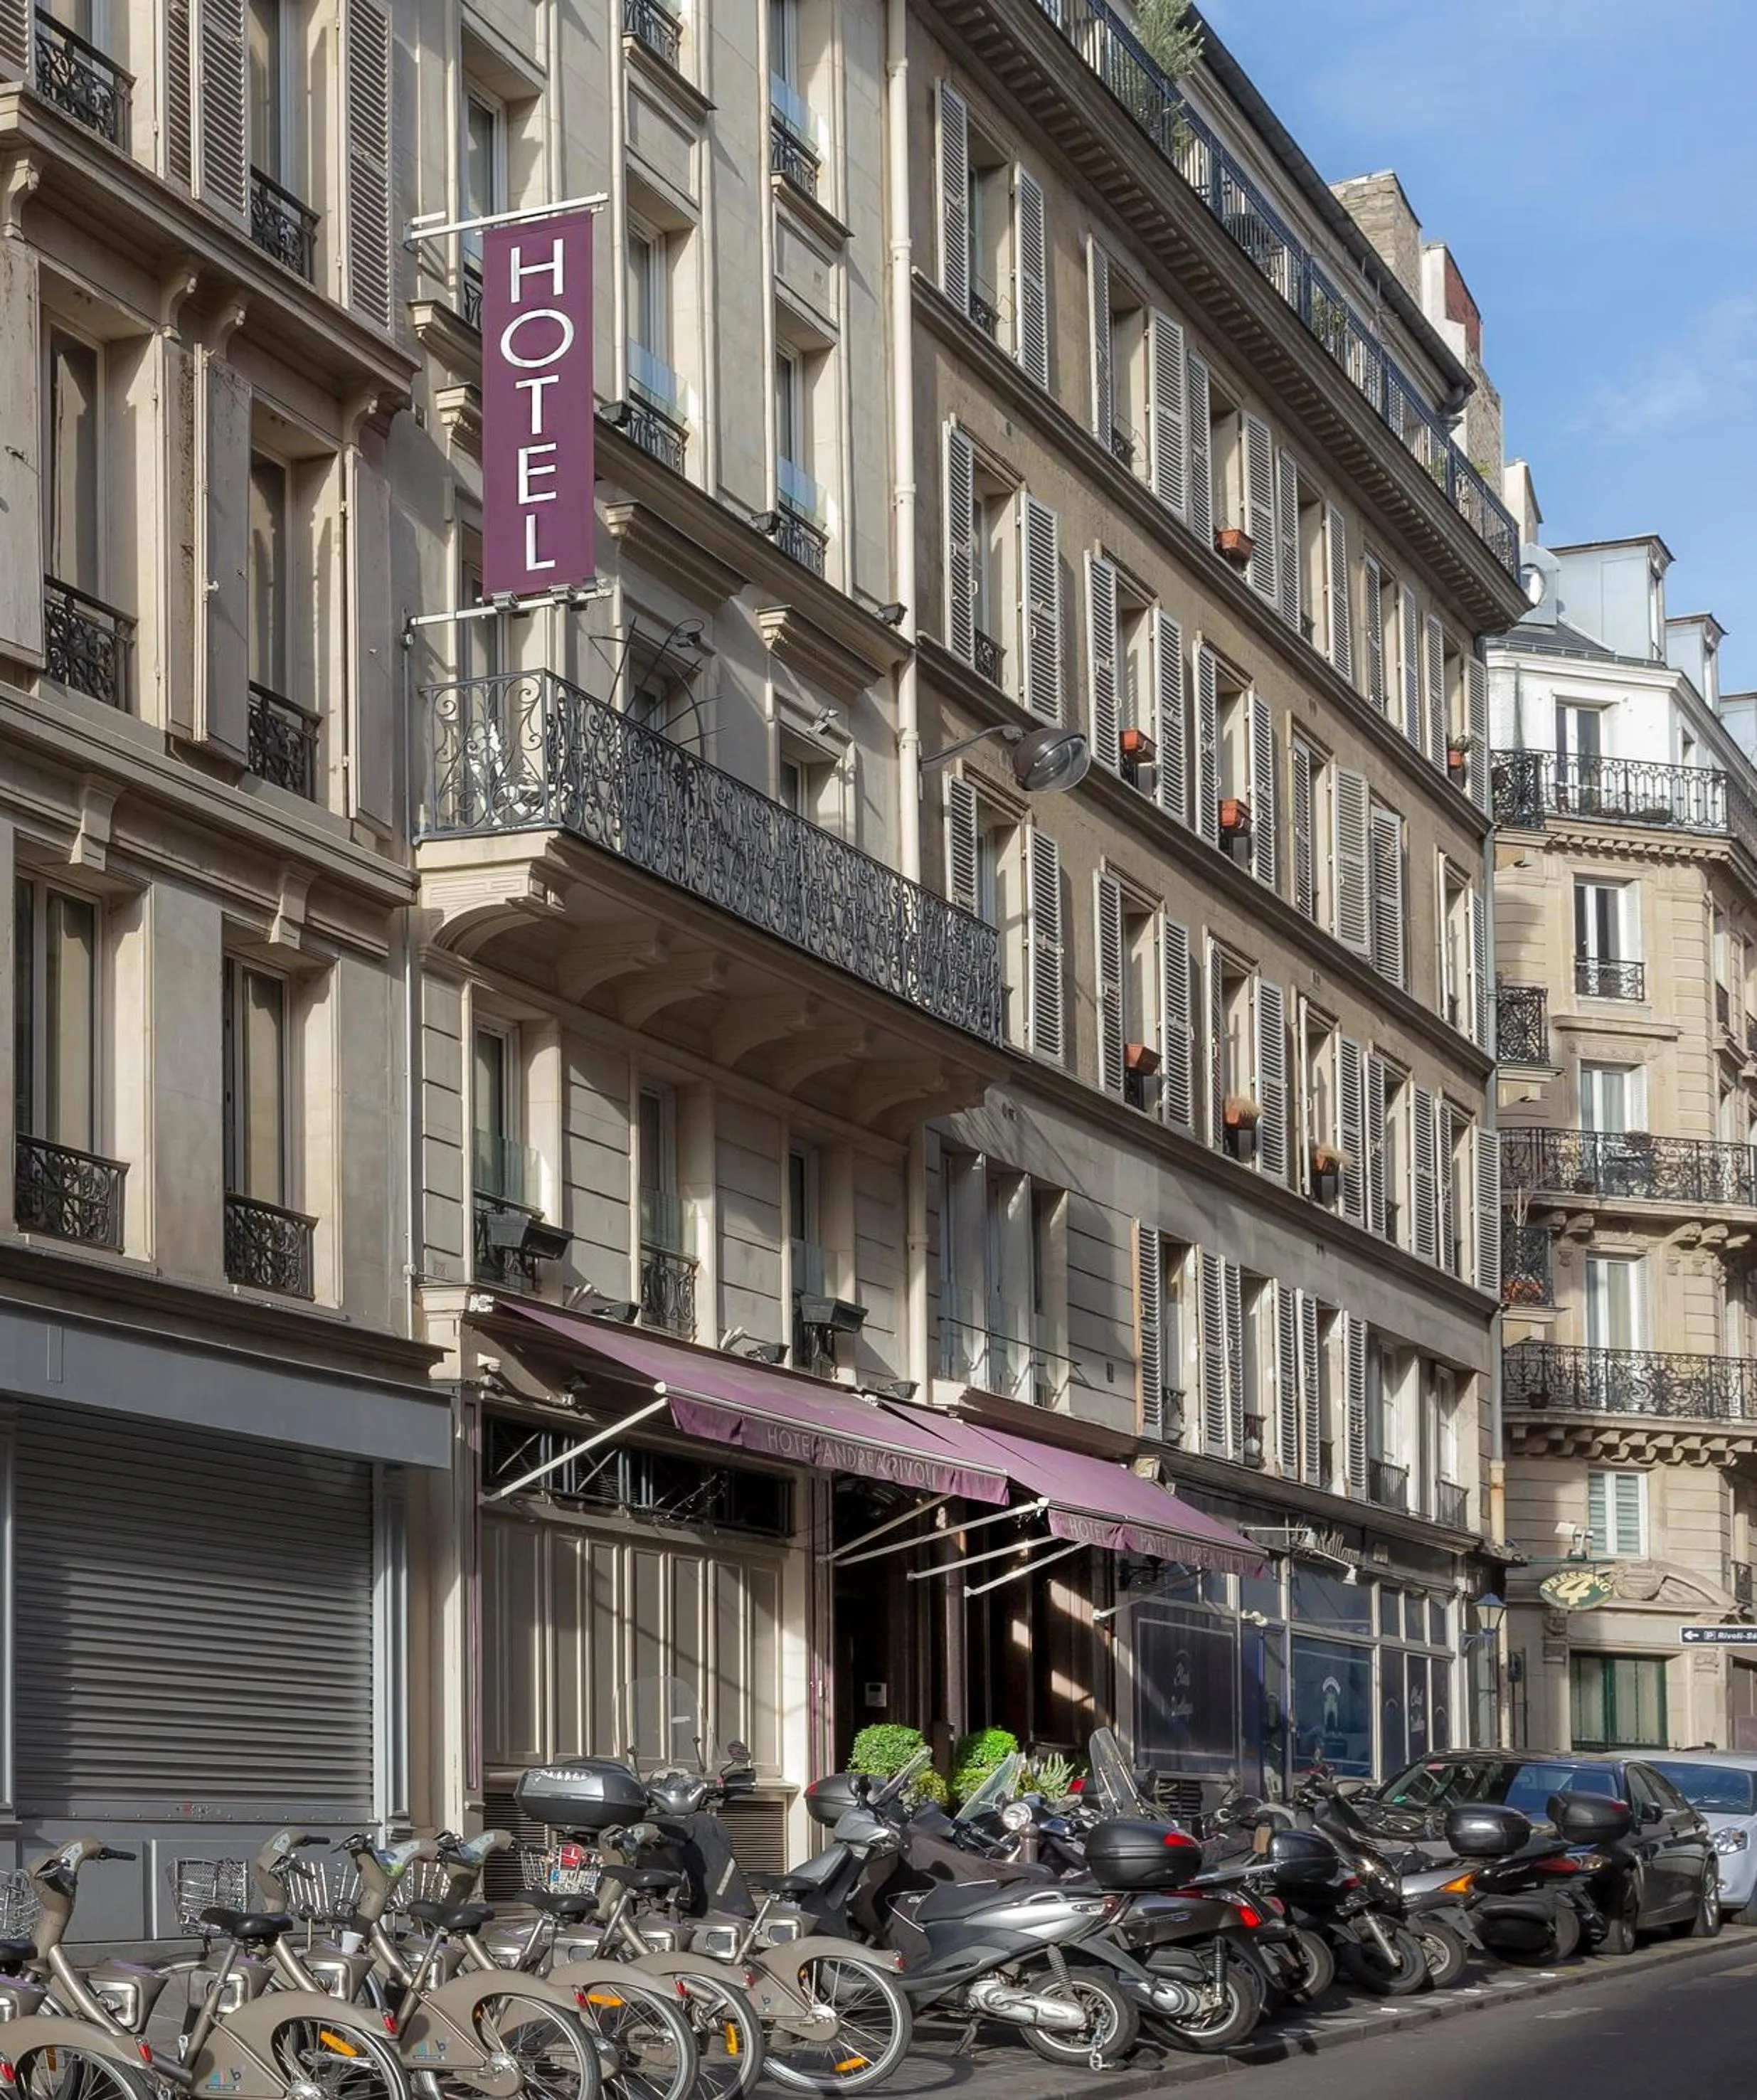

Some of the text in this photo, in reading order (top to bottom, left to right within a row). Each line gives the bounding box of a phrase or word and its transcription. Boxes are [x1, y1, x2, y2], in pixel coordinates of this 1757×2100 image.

[500, 238, 575, 571] HOTEL
[823, 1442, 888, 1476] ANDREA
[1540, 1571, 1612, 1593] PRESSING
[1556, 1577, 1591, 1606] 4
